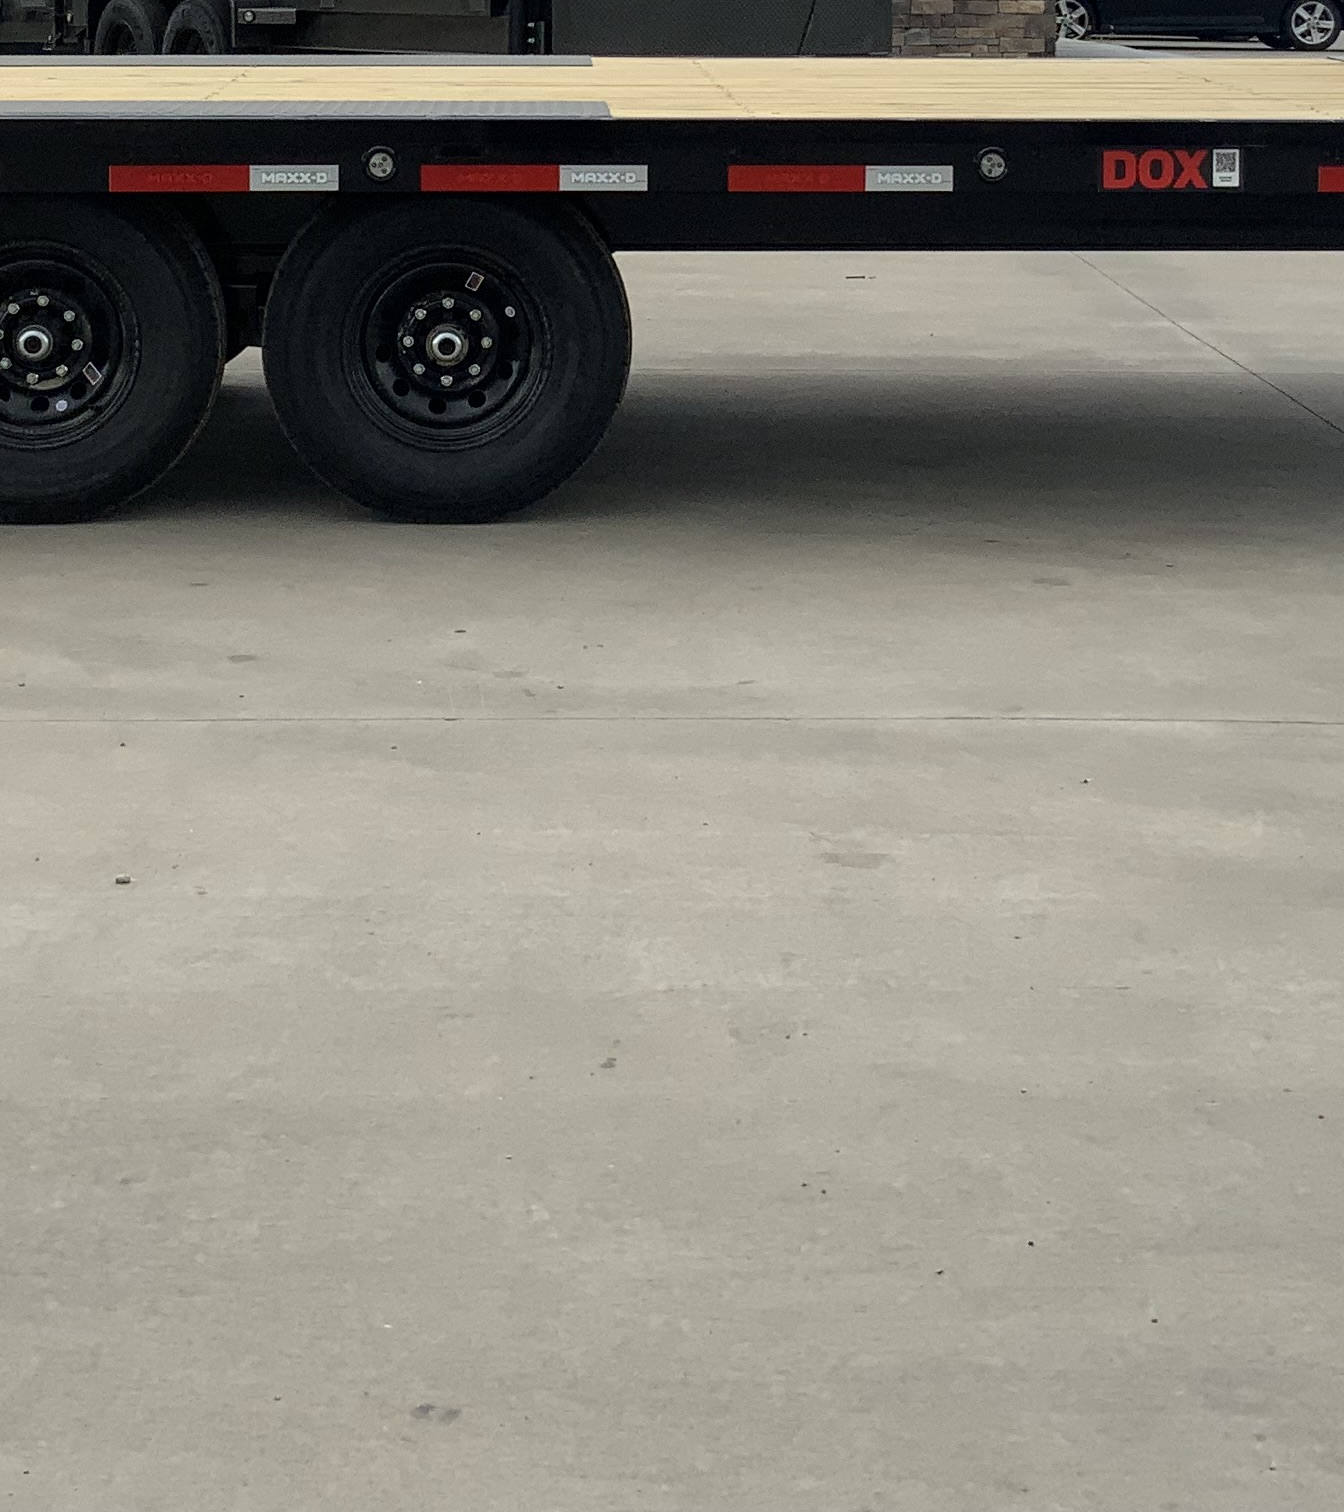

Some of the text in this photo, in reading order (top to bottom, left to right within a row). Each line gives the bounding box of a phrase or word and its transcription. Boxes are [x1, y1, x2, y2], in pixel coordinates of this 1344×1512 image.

[1102, 149, 1208, 190] DOX
[261, 172, 328, 184] MAXX-D
[571, 172, 637, 184] MAXX-D
[877, 172, 943, 184] MAXX-D
